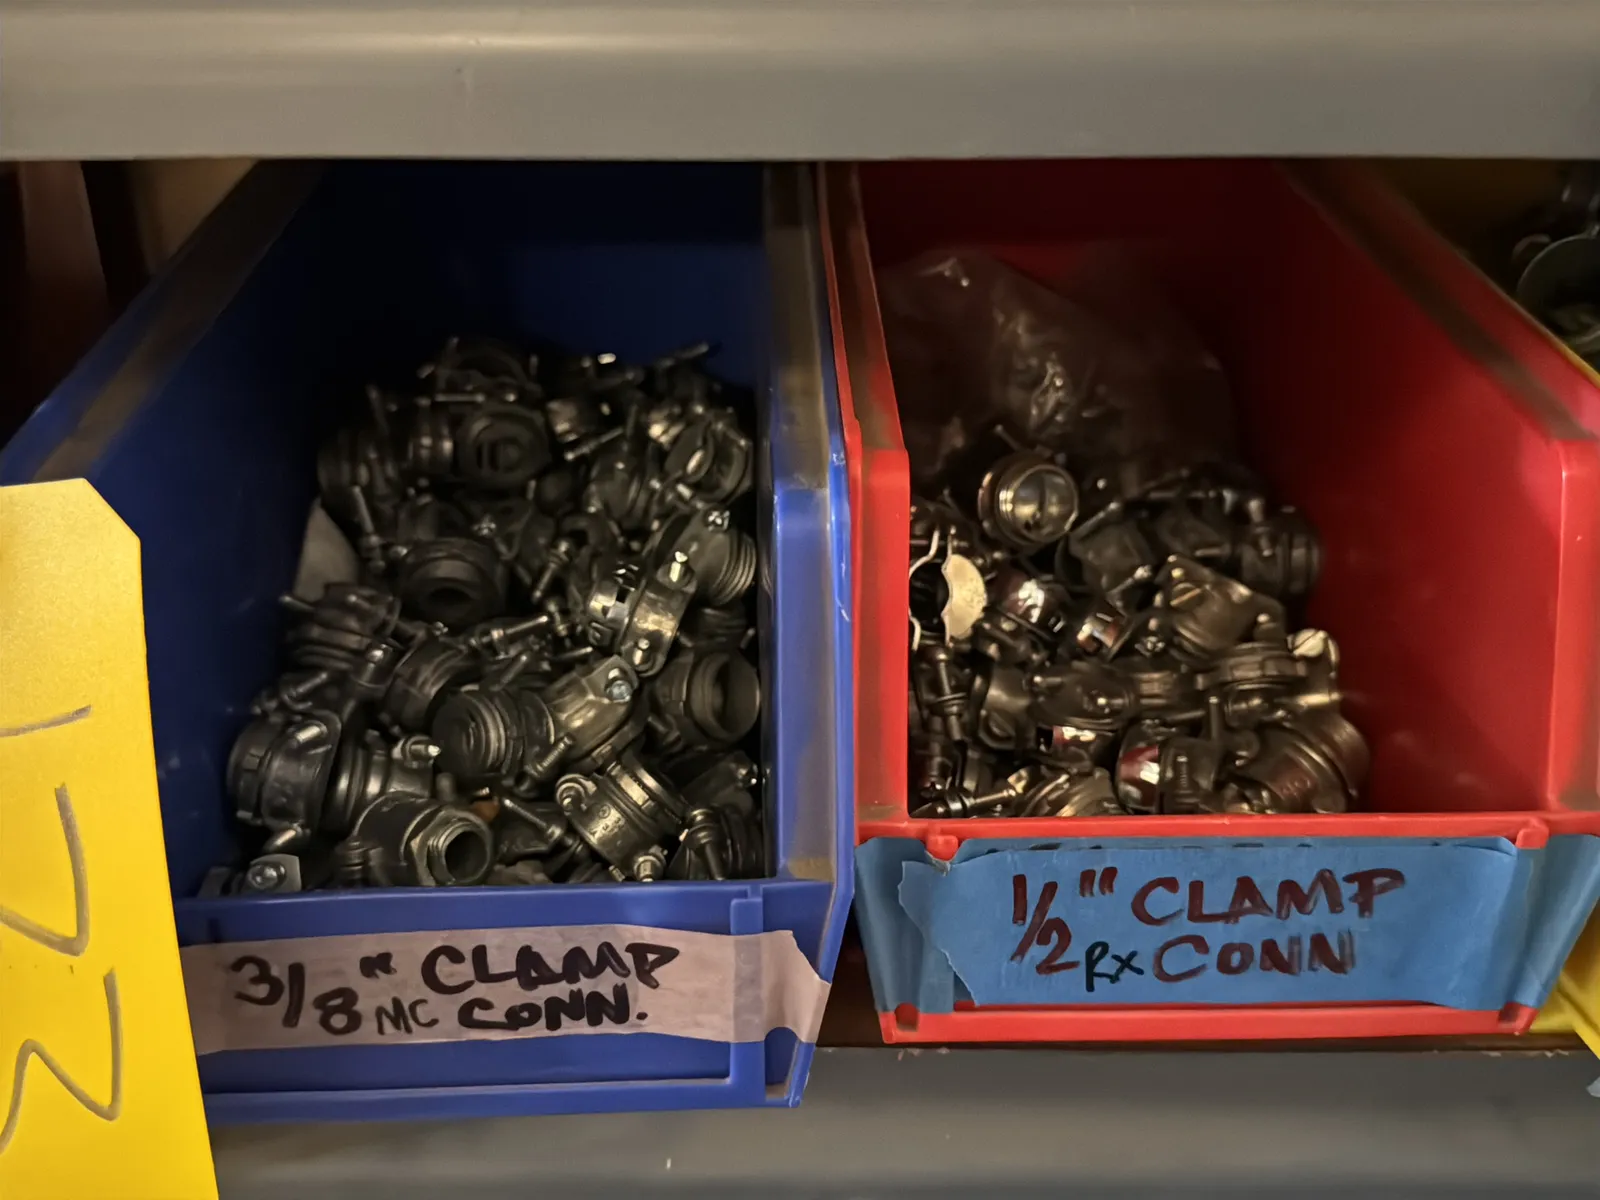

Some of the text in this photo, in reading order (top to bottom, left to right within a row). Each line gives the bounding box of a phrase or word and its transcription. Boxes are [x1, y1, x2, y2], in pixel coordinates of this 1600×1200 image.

[1131, 868, 1405, 926] CLAMP
[421, 941, 680, 994] CLAMP
[1153, 929, 1355, 983] CONN
[457, 982, 648, 1031] CONN.
